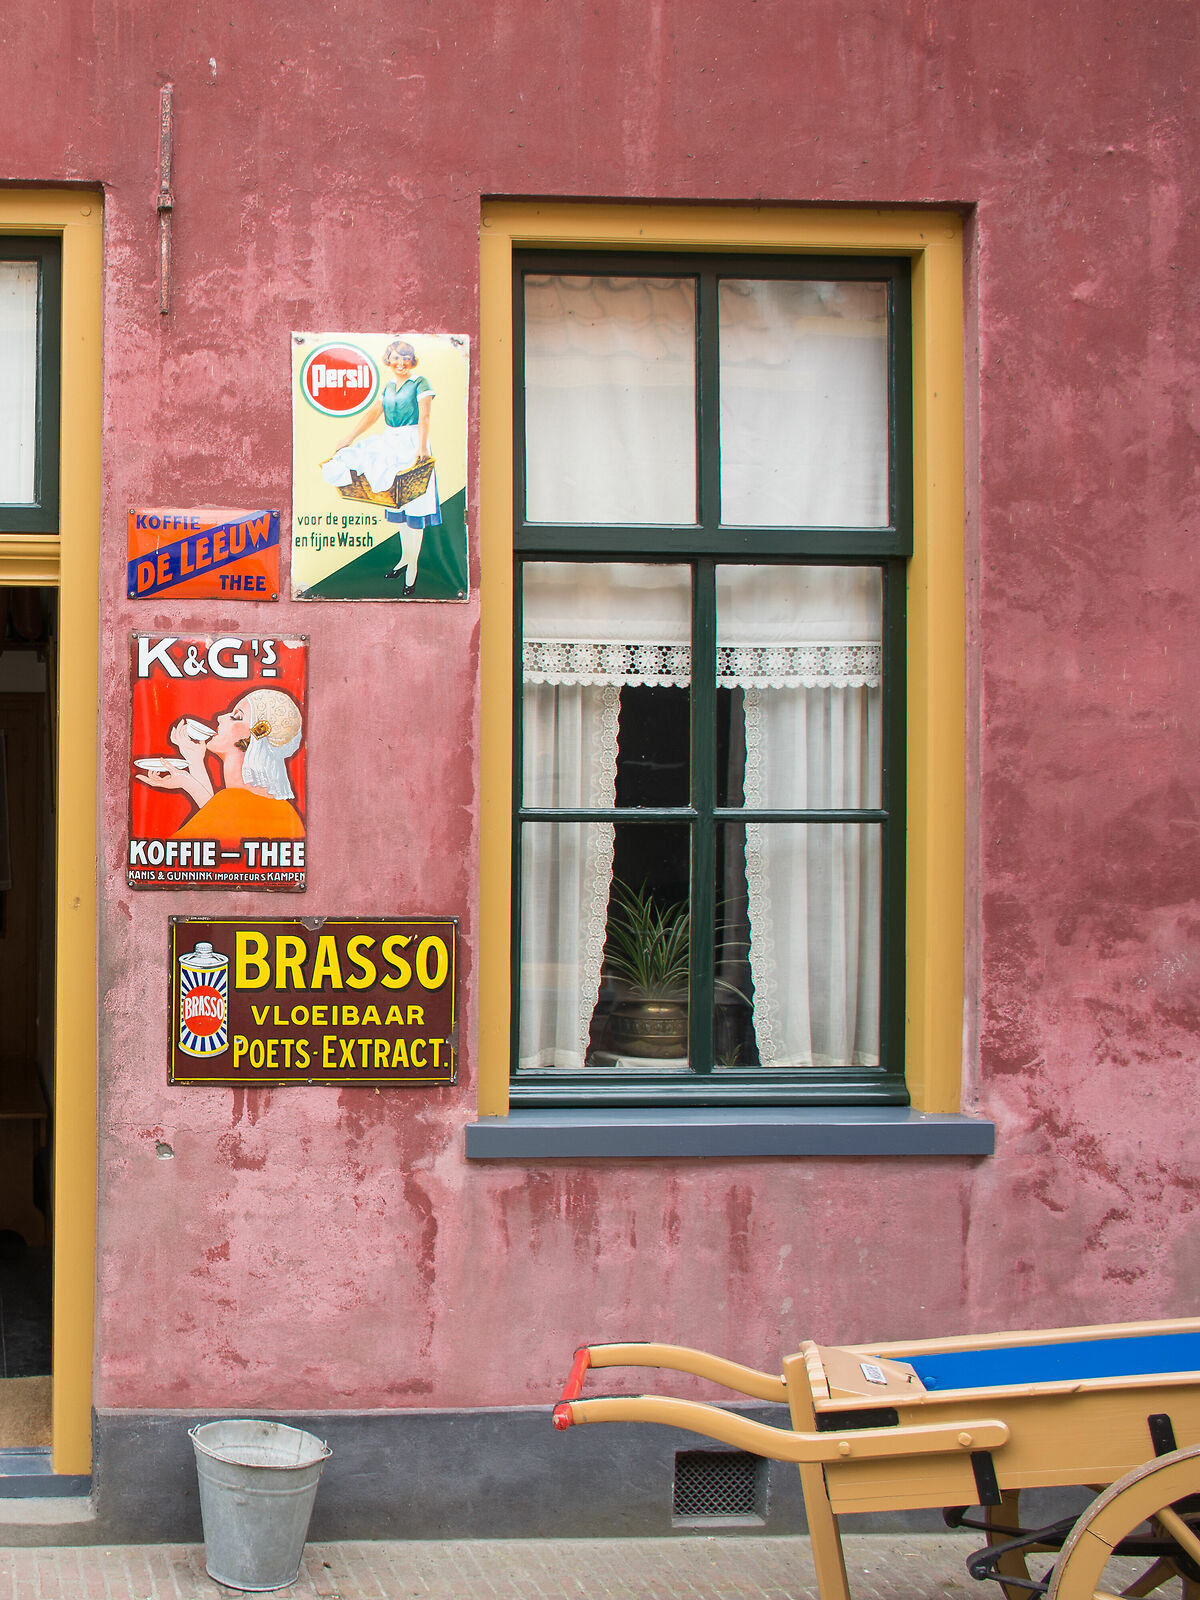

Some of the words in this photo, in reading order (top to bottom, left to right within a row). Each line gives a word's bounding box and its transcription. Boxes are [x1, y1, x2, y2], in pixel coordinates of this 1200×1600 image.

[312, 364, 370, 397] Persil
[136, 514, 200, 530] KOFFIE
[298, 515, 323, 526] voor
[326, 512, 338, 526] de
[295, 536, 308, 547] en
[310, 532, 336, 552] fijne
[337, 531, 373, 547] Wasch
[137, 553, 173, 593] DE
[180, 513, 271, 576] LEEUW
[219, 574, 267, 591] THEE
[130, 840, 216, 866] KOFFIE
[244, 842, 305, 867] THEE
[128, 870, 156, 880] KANIS
[157, 871, 165, 880] &
[166, 871, 213, 881] GUNNINK
[214, 873, 266, 881] IMPORTEURS
[267, 872, 305, 882] KAMPEN
[235, 931, 449, 990] BRASSO
[184, 995, 225, 1020] BRASSO
[251, 1005, 425, 1026] VLOEIBAAR
